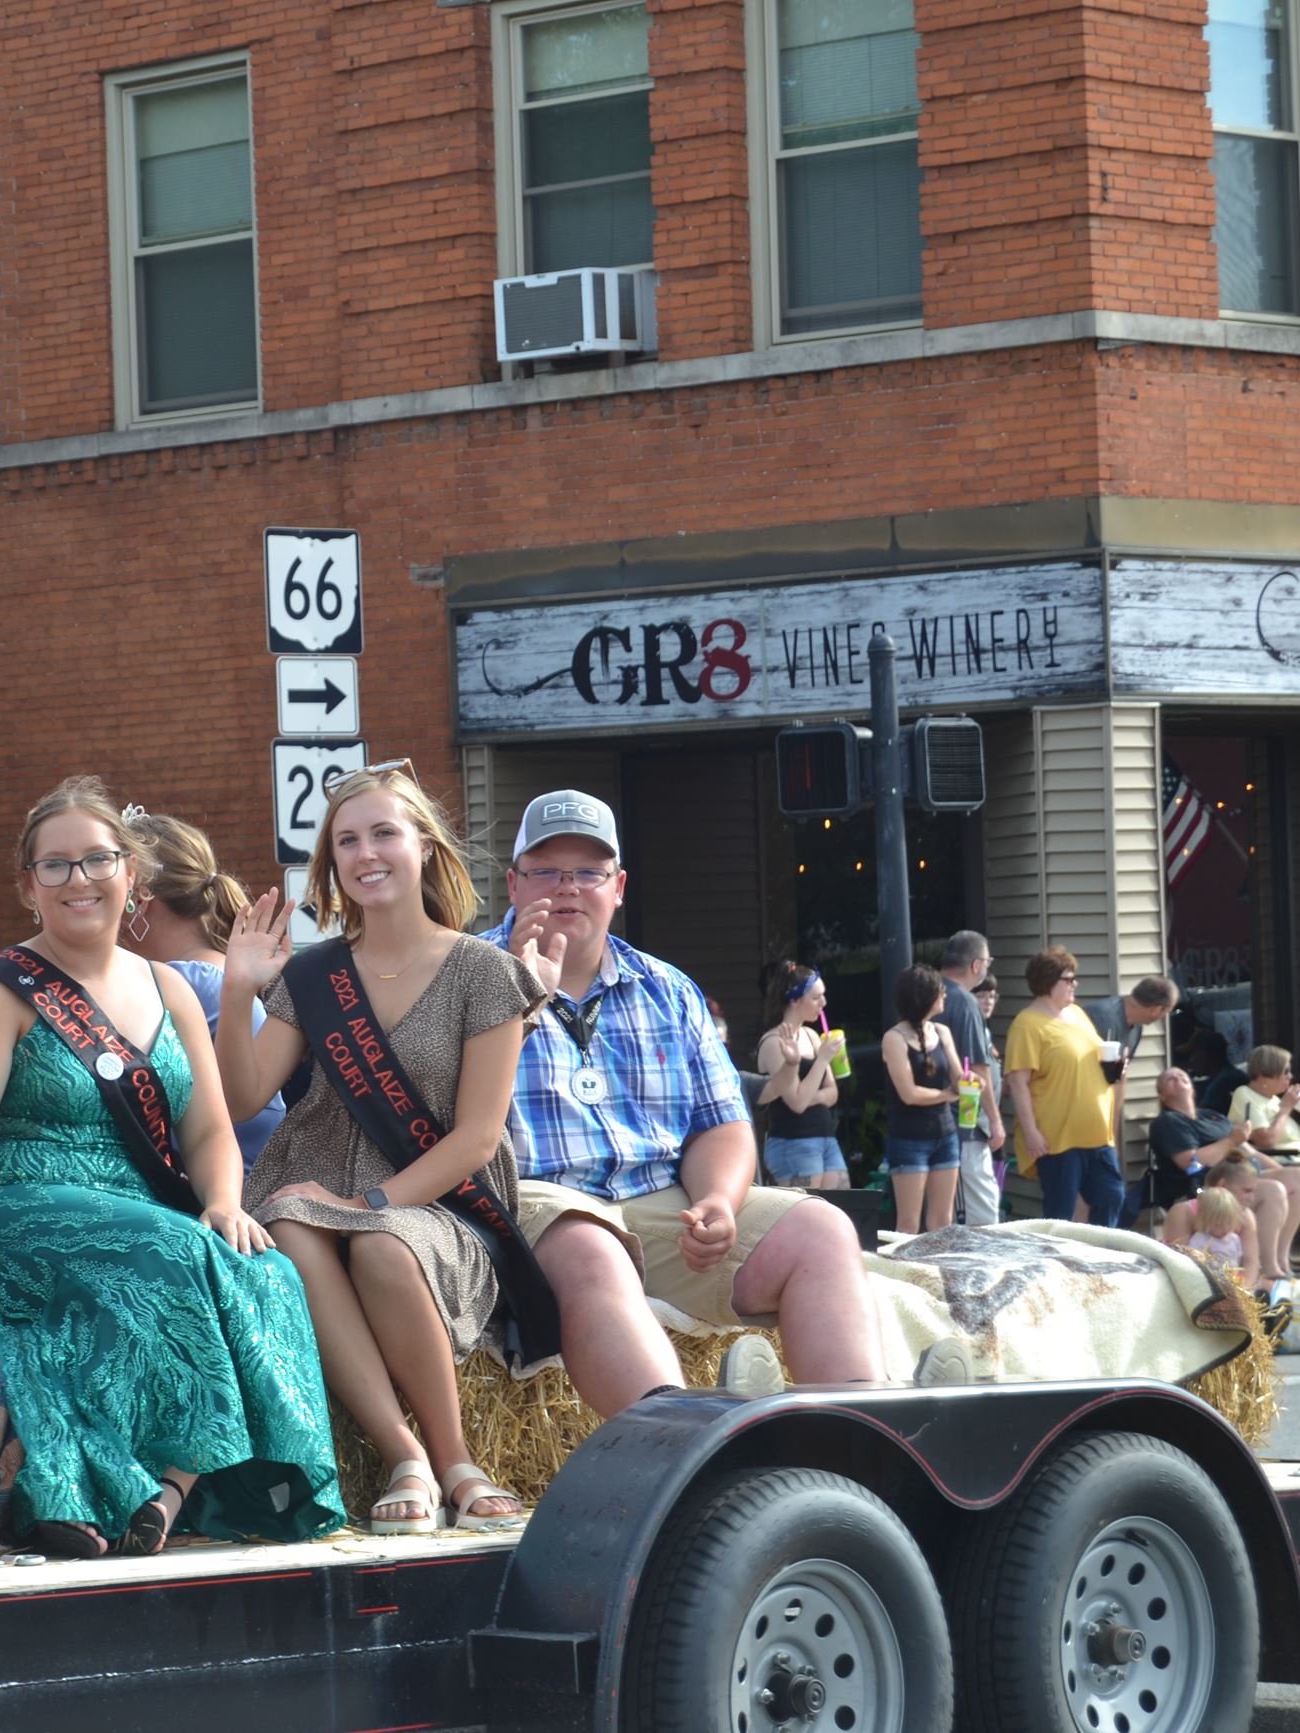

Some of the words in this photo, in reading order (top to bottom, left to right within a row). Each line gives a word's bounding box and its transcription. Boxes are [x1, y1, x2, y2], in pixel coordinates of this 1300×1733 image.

[284, 556, 343, 621] 66
[570, 616, 753, 706] GR8
[911, 605, 1061, 681] WINERY
[32, 992, 96, 1050] COURT
[329, 969, 359, 1012] 2021
[348, 1017, 414, 1117] AUGLAIZE
[45, 979, 136, 1064] AUGLAIZE
[132, 1069, 169, 1152] COUNTY
[325, 1032, 373, 1098] COURT
